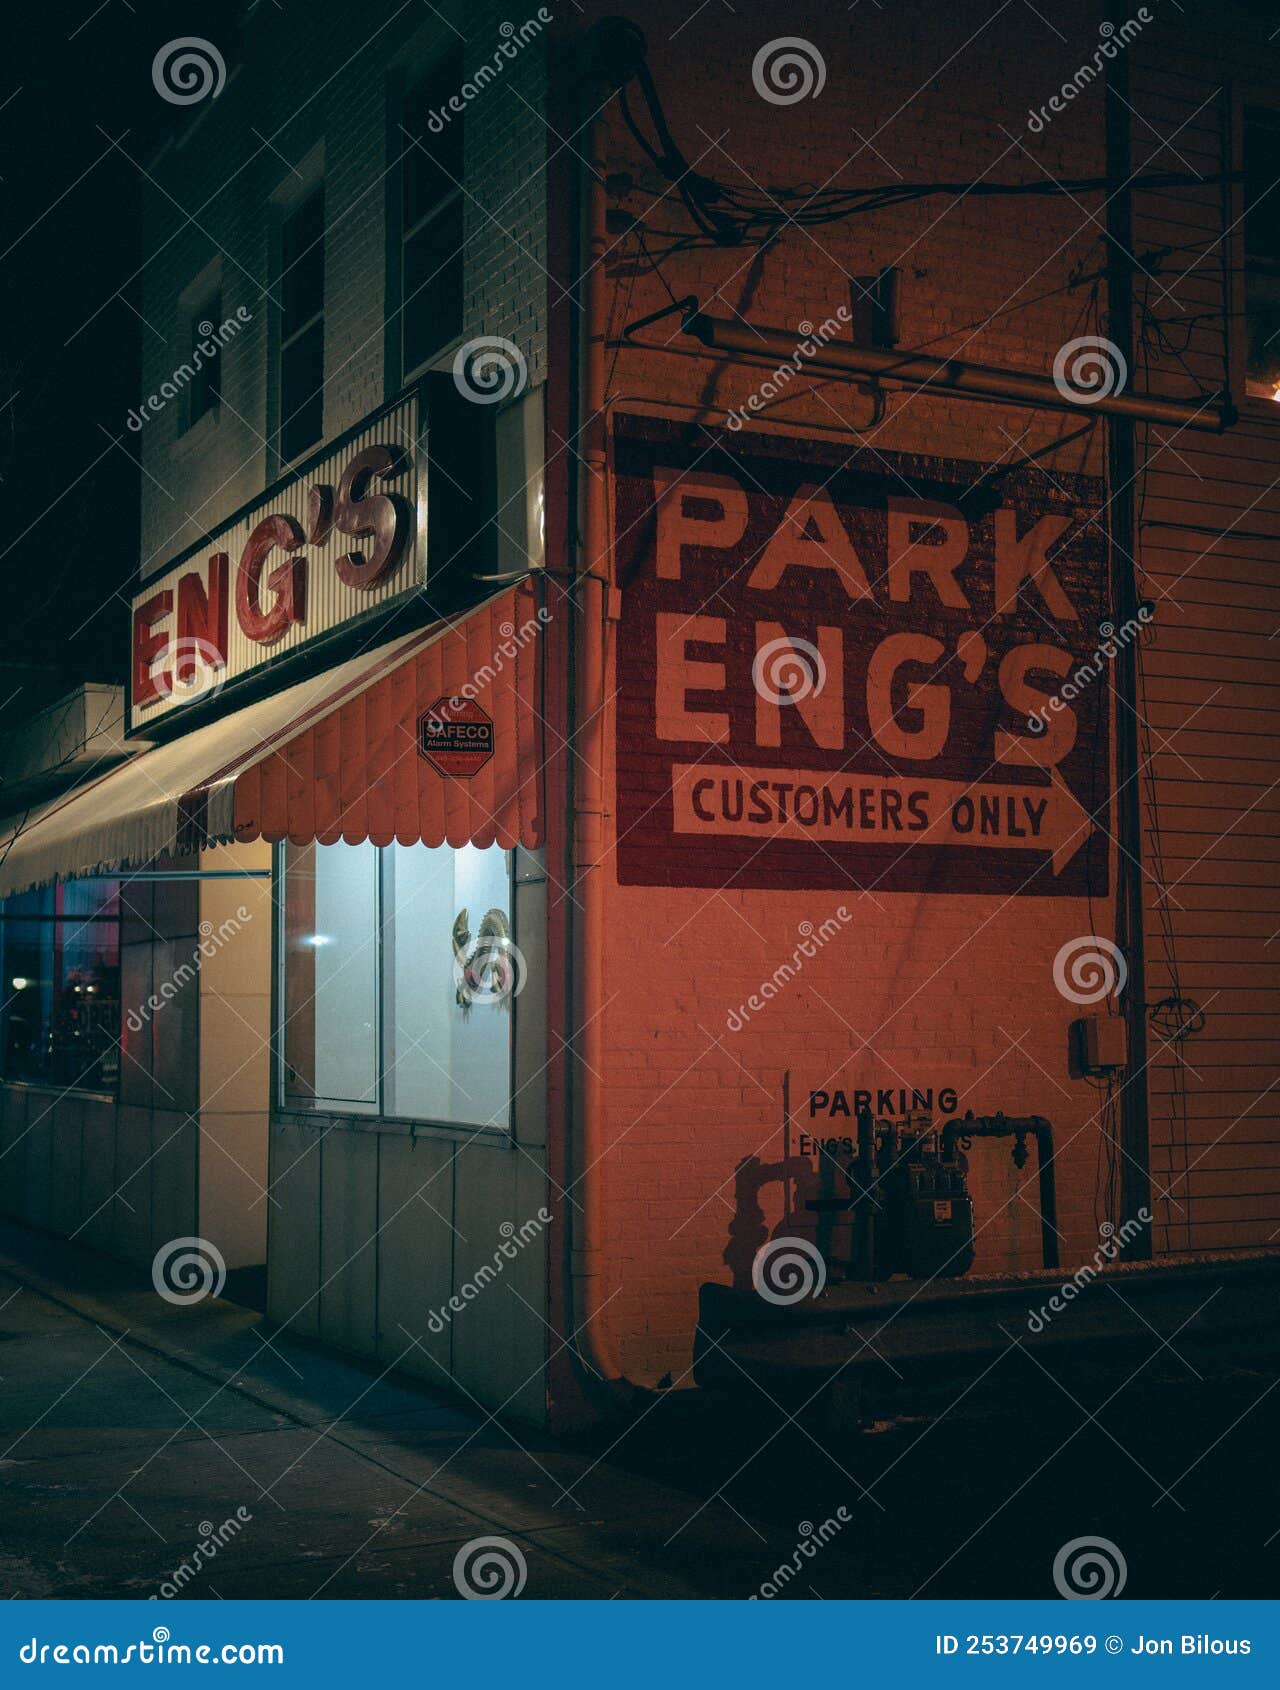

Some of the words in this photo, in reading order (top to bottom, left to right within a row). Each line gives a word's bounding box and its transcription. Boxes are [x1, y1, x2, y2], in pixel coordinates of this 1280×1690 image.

[653, 465, 1080, 621] PARK
[133, 443, 414, 711] ENG'S
[654, 612, 1079, 767] ENG'S
[426, 725, 490, 739] SAFECO
[454, 740, 489, 749] Systems
[691, 779, 930, 832] CUSTOMERS
[951, 797, 1049, 837] ONLY
[809, 1088, 958, 1117] PARKING
